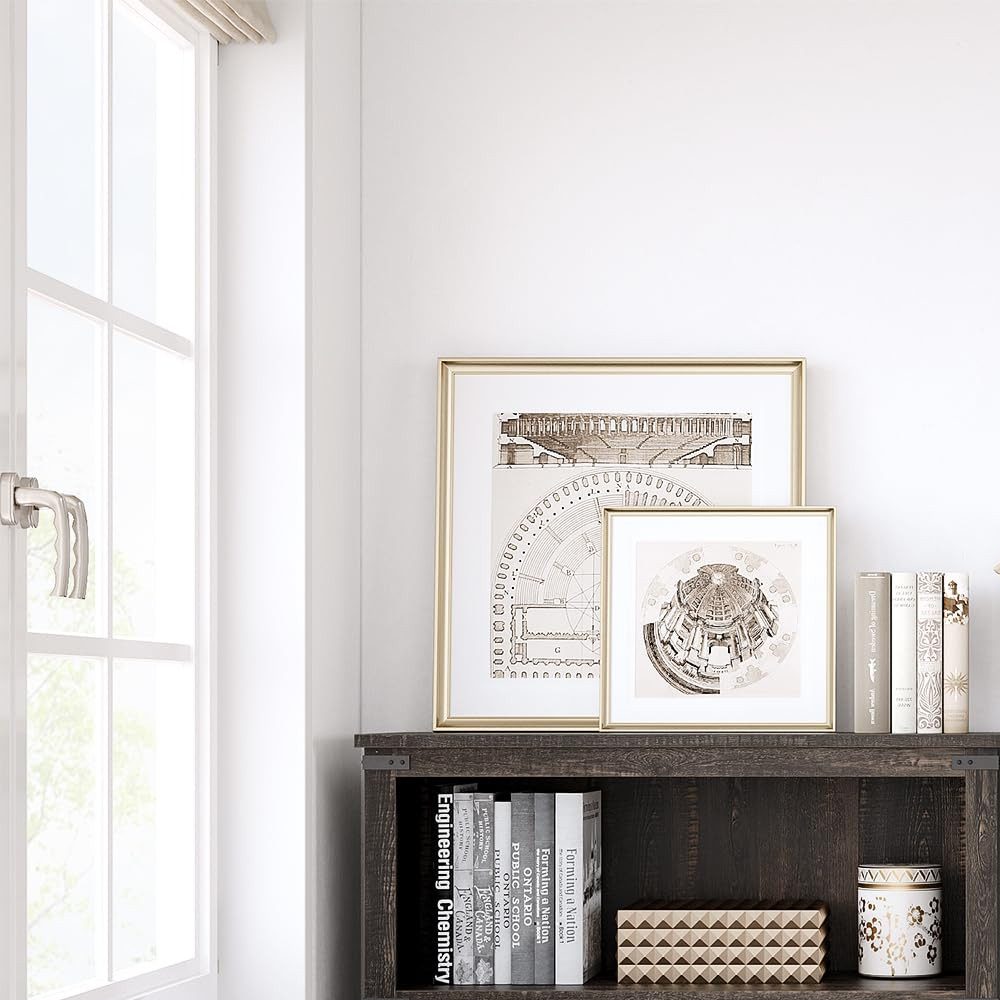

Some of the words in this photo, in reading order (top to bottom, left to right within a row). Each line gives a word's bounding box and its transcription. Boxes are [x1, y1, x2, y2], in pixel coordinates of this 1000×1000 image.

[435, 794, 453, 889] Engineering
[481, 808, 491, 833] PUBLIC
[481, 835, 491, 863] SCHOOL
[511, 842, 520, 889] PUBLIC
[541, 848, 551, 895] Forming
[564, 848, 577, 895] Forming
[454, 886, 473, 935] ENGLAND
[474, 885, 493, 935] ENGLAND
[523, 867, 533, 926] ONTARIO
[435, 899, 453, 984] Chemistry
[511, 896, 520, 949] SCHOOL
[541, 907, 551, 944] Nation
[566, 907, 578, 944] Nation
